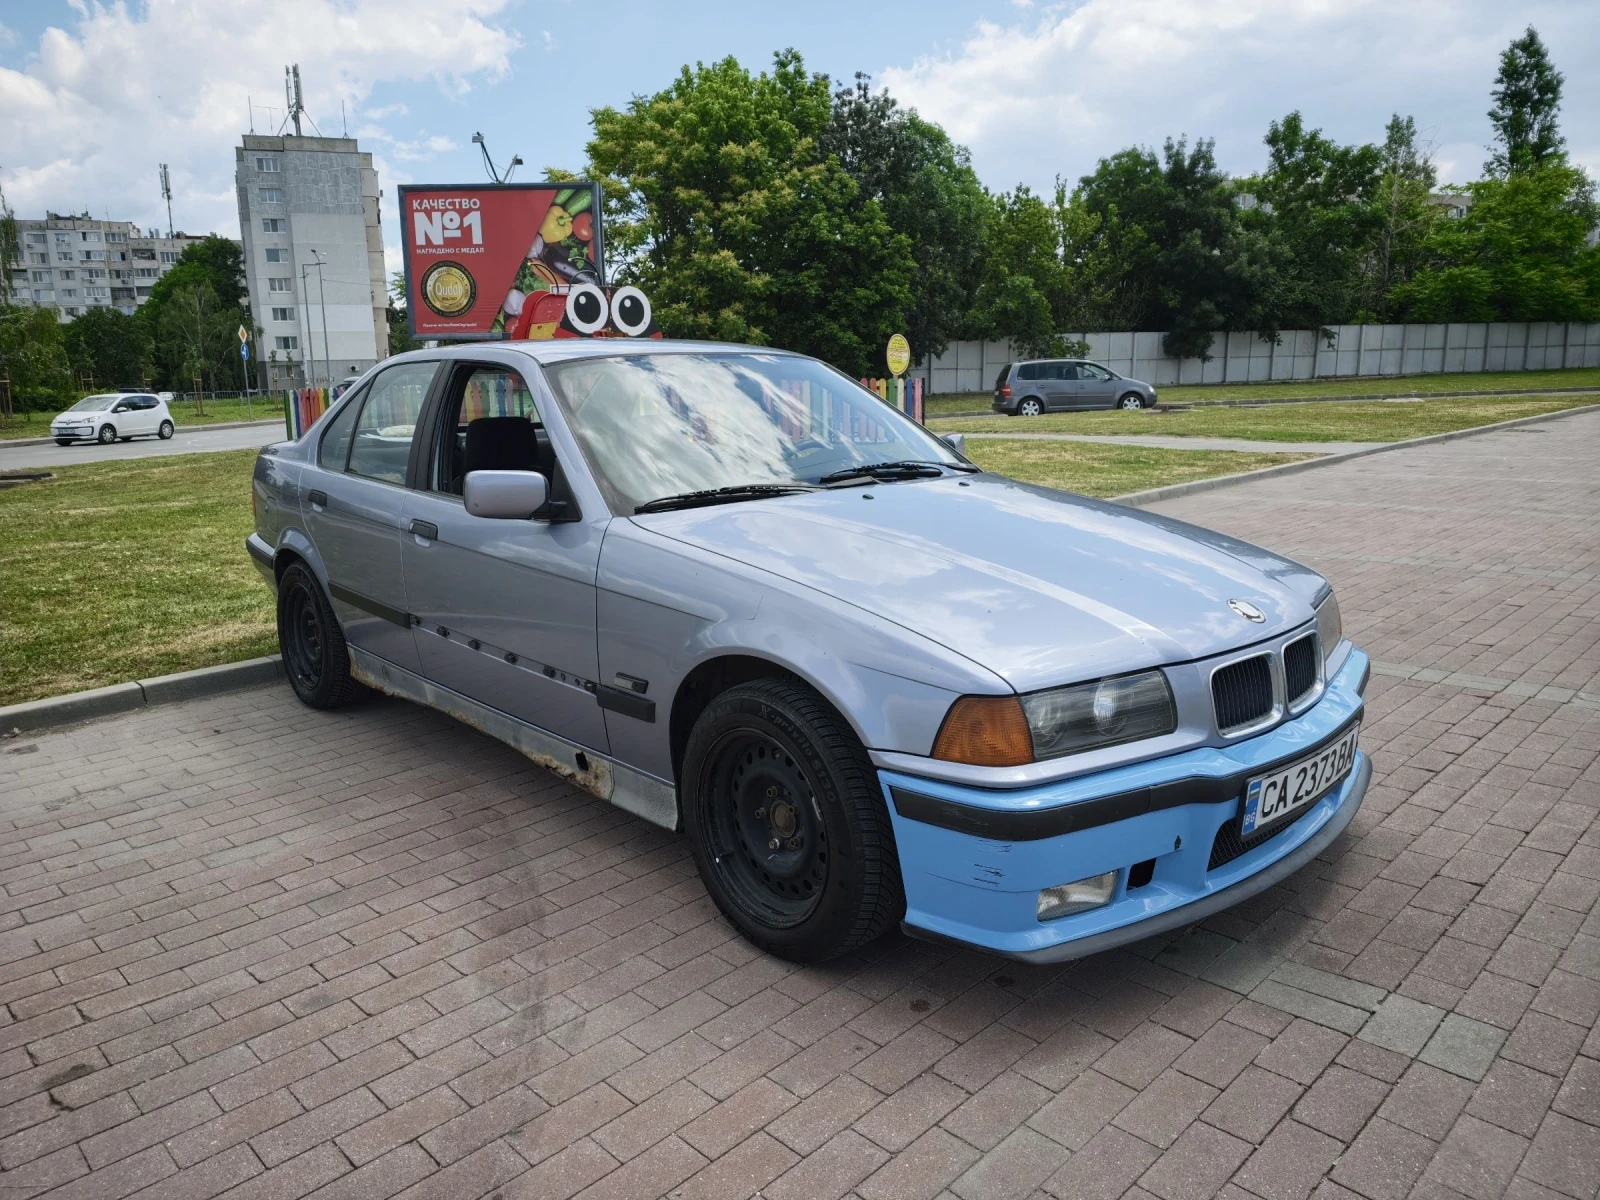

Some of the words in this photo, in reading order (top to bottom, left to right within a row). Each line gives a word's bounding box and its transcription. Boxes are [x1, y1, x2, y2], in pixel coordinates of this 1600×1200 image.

[412, 198, 480, 210] КАЧЕСТВО
[811, 761, 836, 802] S130
[1261, 775, 1289, 818] CA
[1245, 811, 1256, 825] BG
